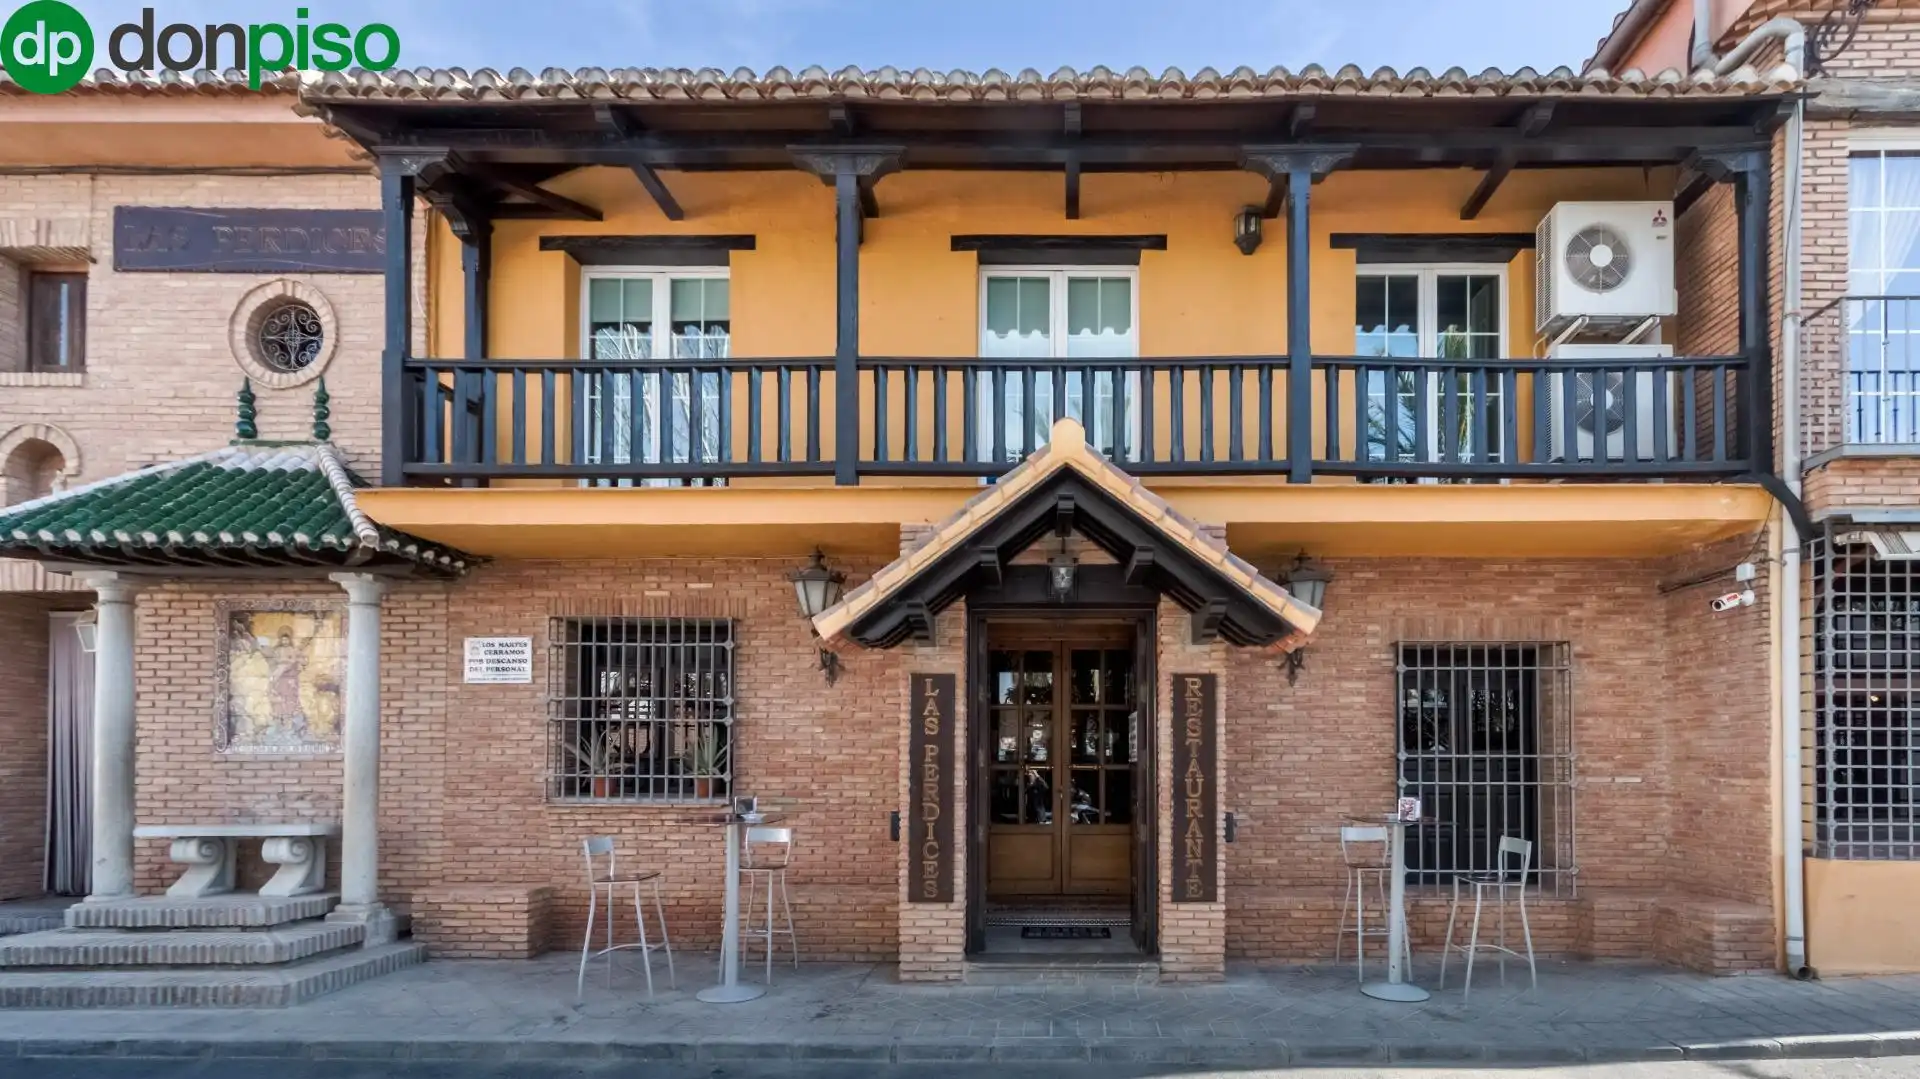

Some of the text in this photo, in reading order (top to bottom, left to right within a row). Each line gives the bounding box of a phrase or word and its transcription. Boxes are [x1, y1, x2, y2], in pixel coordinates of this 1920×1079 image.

[123, 225, 187, 252] LAS
[922, 678, 940, 899] LAS PERDICES
[1184, 677, 1205, 899] RESTAURANTE
